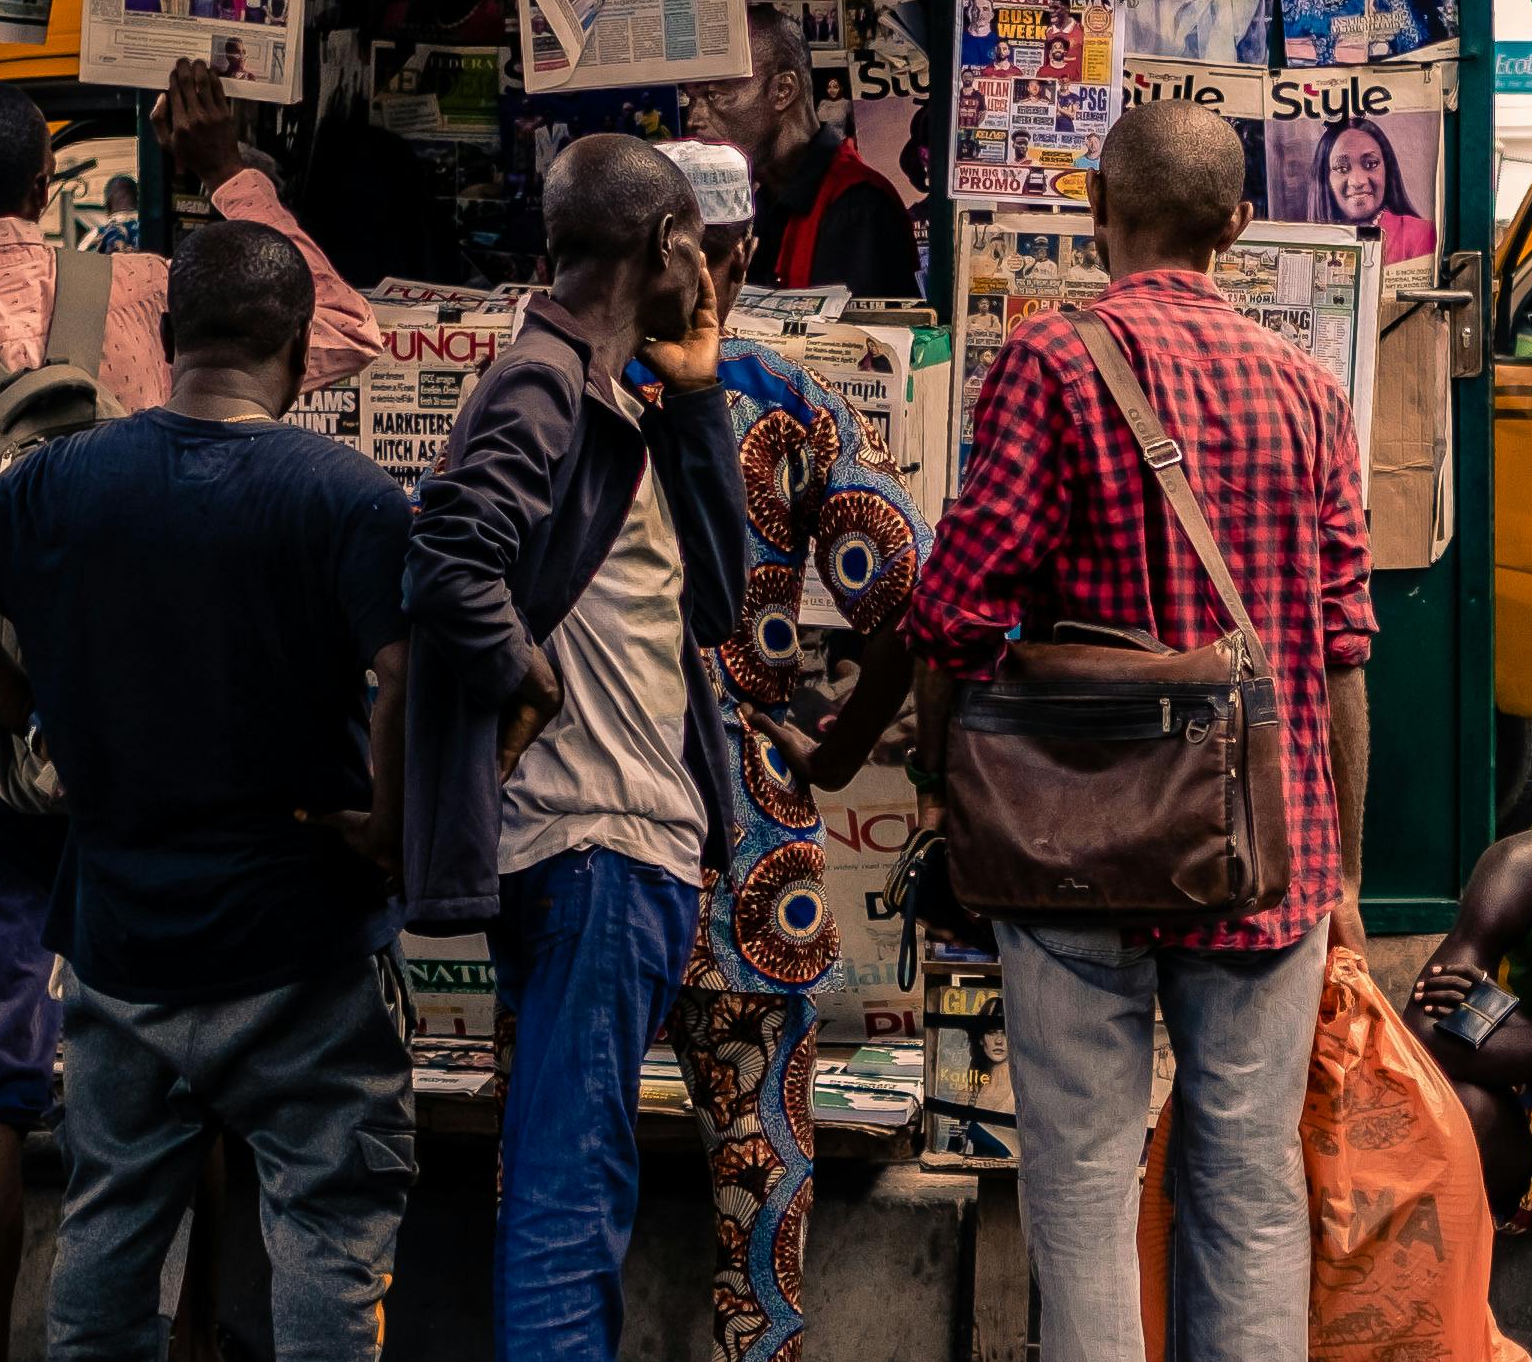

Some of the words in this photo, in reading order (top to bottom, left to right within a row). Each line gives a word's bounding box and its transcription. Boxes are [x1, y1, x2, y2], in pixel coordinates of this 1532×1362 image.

[998, 9, 1044, 25] BUSY
[997, 24, 1048, 40] WEEK
[1078, 87, 1108, 112] PSG
[1271, 76, 1393, 123] Style
[958, 177, 1021, 193] PROMO
[373, 412, 454, 435] MARKETERS
[373, 438, 413, 462] HITCH
[417, 439, 437, 462] AS
